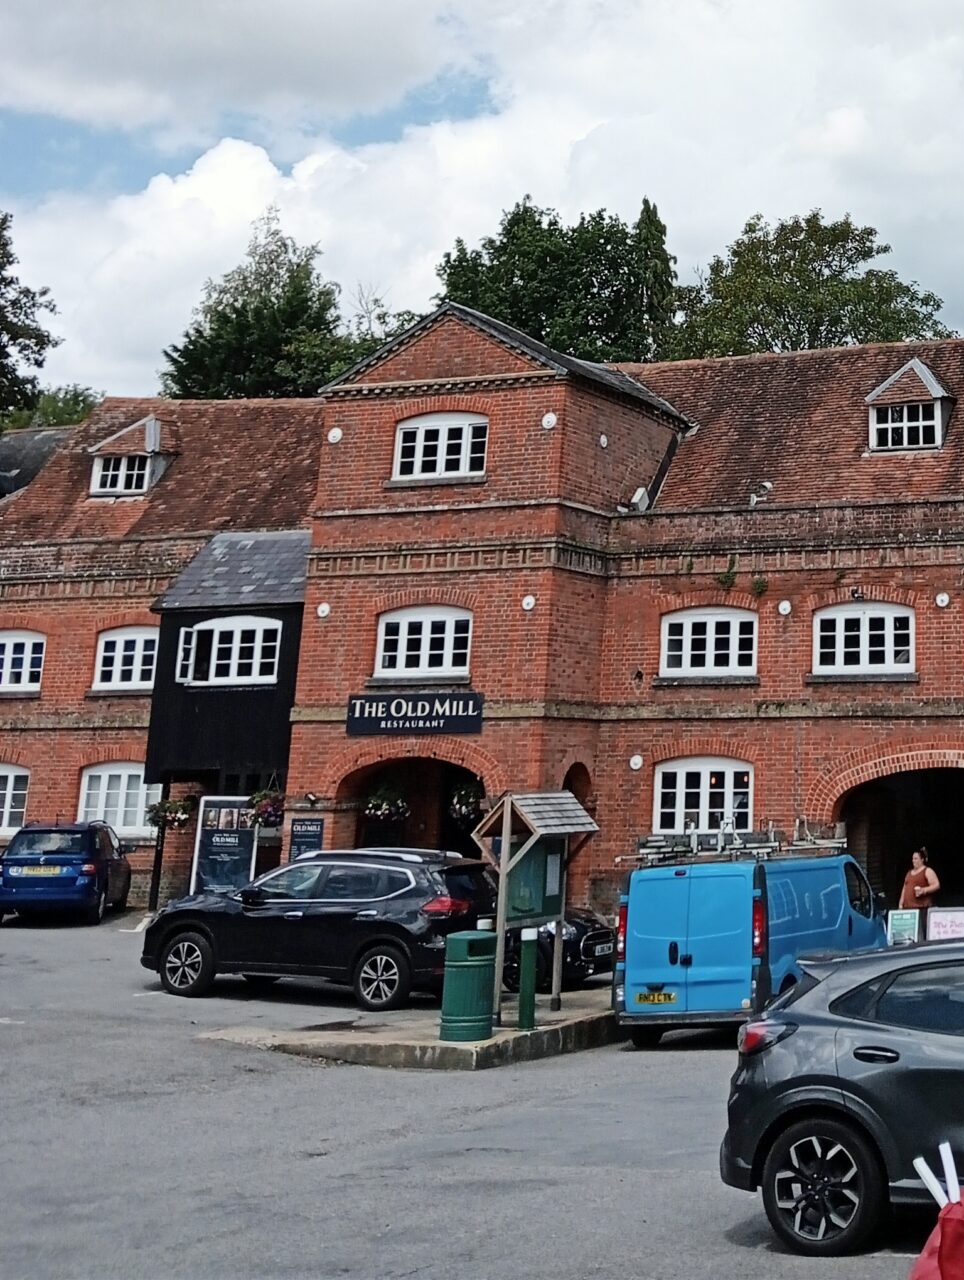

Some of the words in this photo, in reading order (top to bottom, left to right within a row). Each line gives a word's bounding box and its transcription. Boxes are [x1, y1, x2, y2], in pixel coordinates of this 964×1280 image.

[351, 699, 387, 718] THE
[390, 698, 430, 717] OLD
[432, 698, 478, 716] MILL
[380, 719, 445, 728] RESTAURANT
